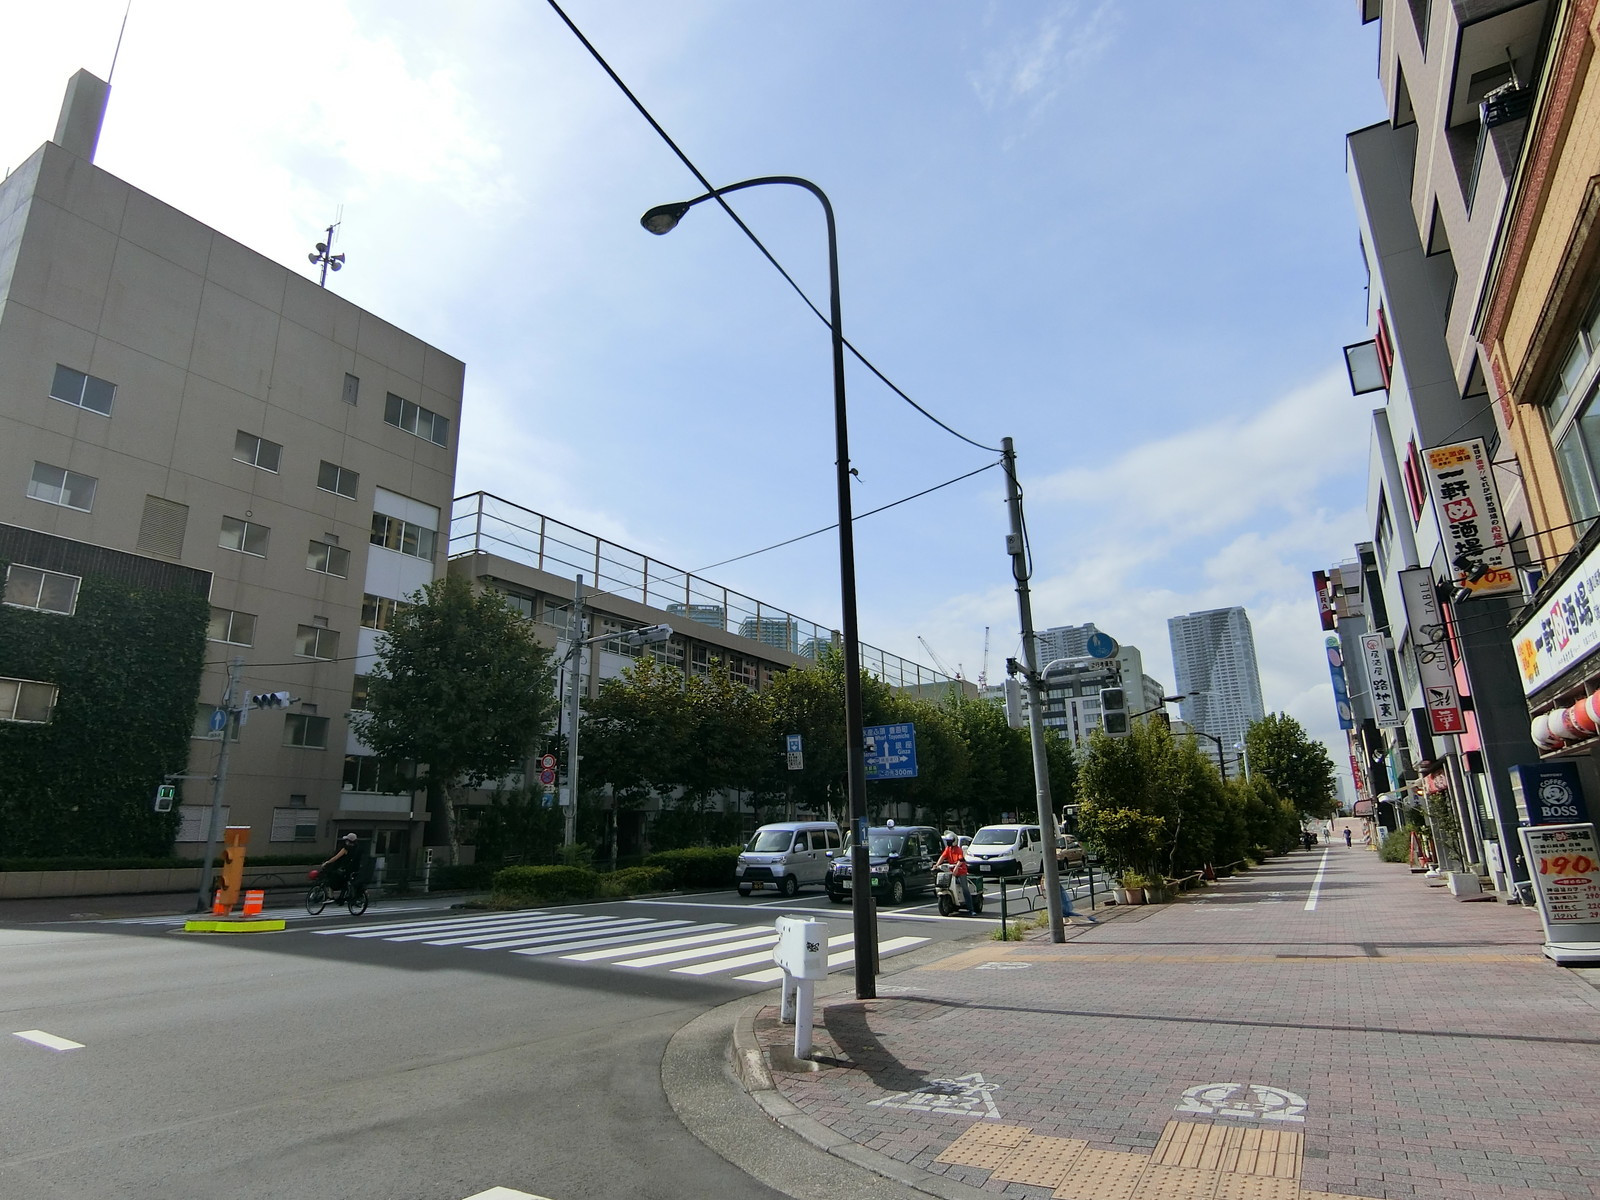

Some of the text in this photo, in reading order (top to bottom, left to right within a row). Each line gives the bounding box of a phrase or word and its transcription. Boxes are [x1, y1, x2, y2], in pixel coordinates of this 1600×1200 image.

[1437, 469, 1484, 557] 一軒め酒場
[1319, 590, 1329, 610] ERA
[1420, 582, 1434, 614] TABLE
[1535, 581, 1594, 657] 一軒め酒場
[1370, 650, 1383, 676] 居酒屋
[1373, 680, 1393, 717] 路地裏
[1540, 778, 1568, 788] COFFEE
[1541, 805, 1578, 817] BOSS
[1531, 831, 1591, 842] 一軒め酒場
